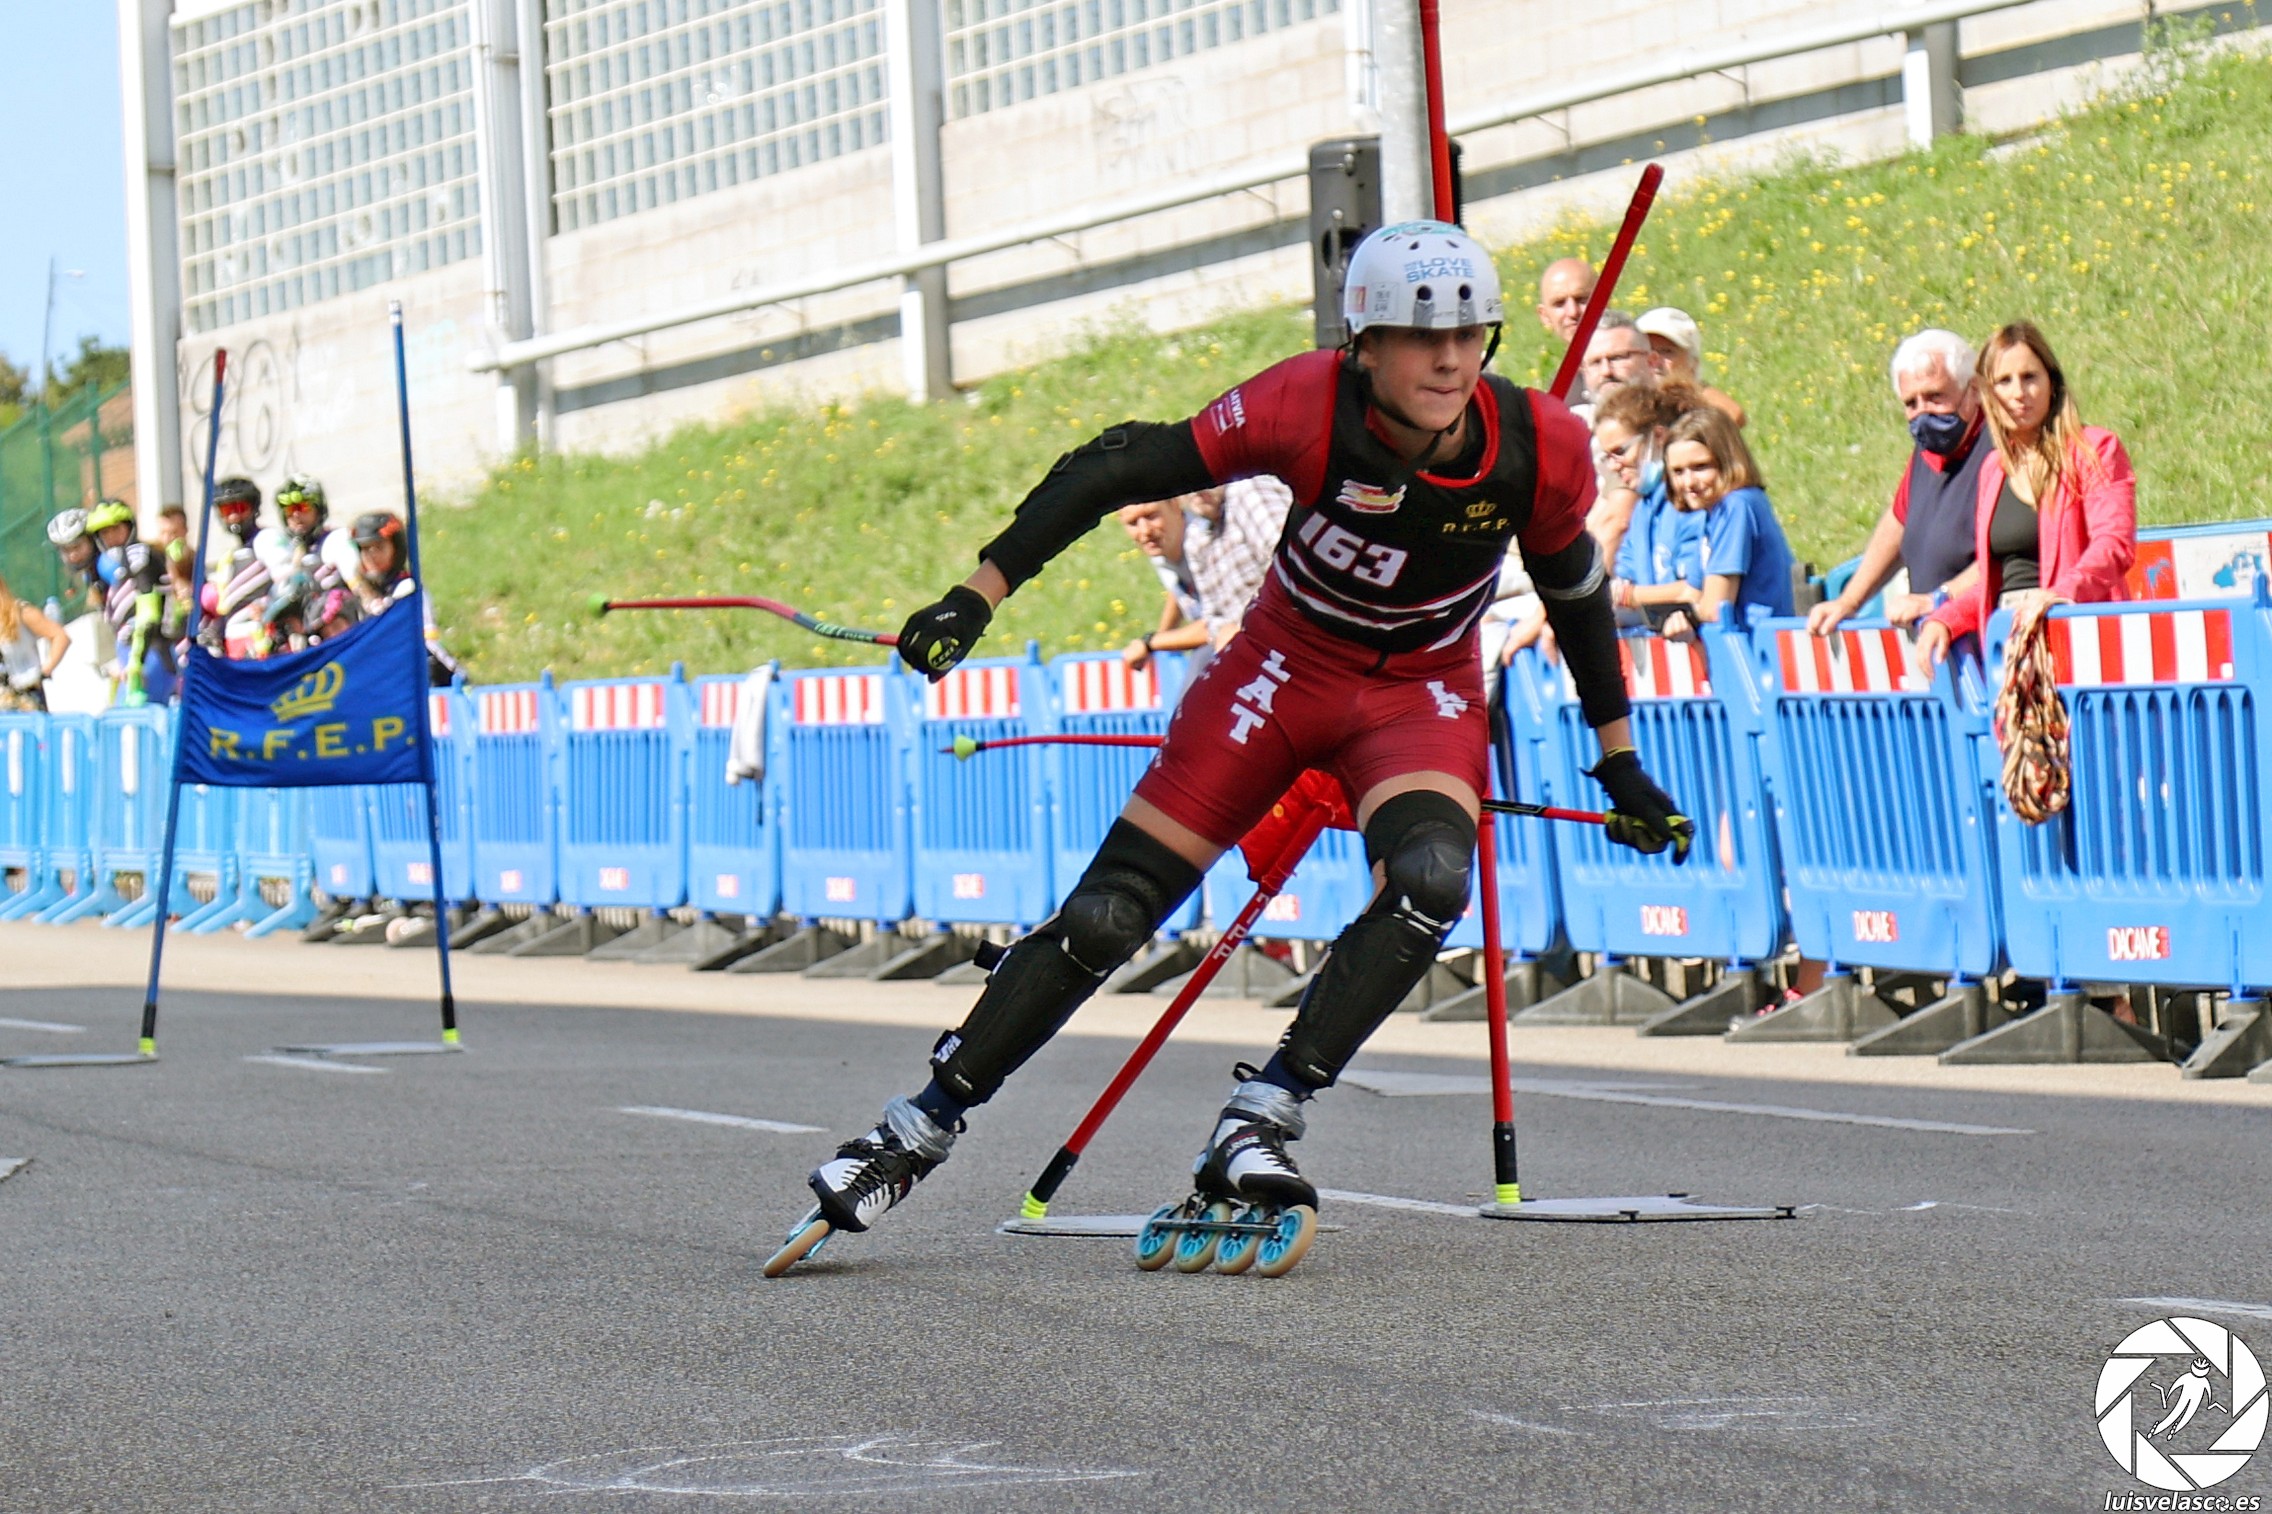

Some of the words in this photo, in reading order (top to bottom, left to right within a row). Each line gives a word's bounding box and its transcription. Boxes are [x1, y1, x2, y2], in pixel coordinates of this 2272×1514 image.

[1405, 266, 1476, 283] SKATE
[1229, 388, 1246, 428] LATVIA
[1298, 511, 1409, 589] 163
[1229, 649, 1291, 745] LAT
[208, 716, 416, 761] R.F.E.P.
[2107, 926, 2161, 960] DACAME
